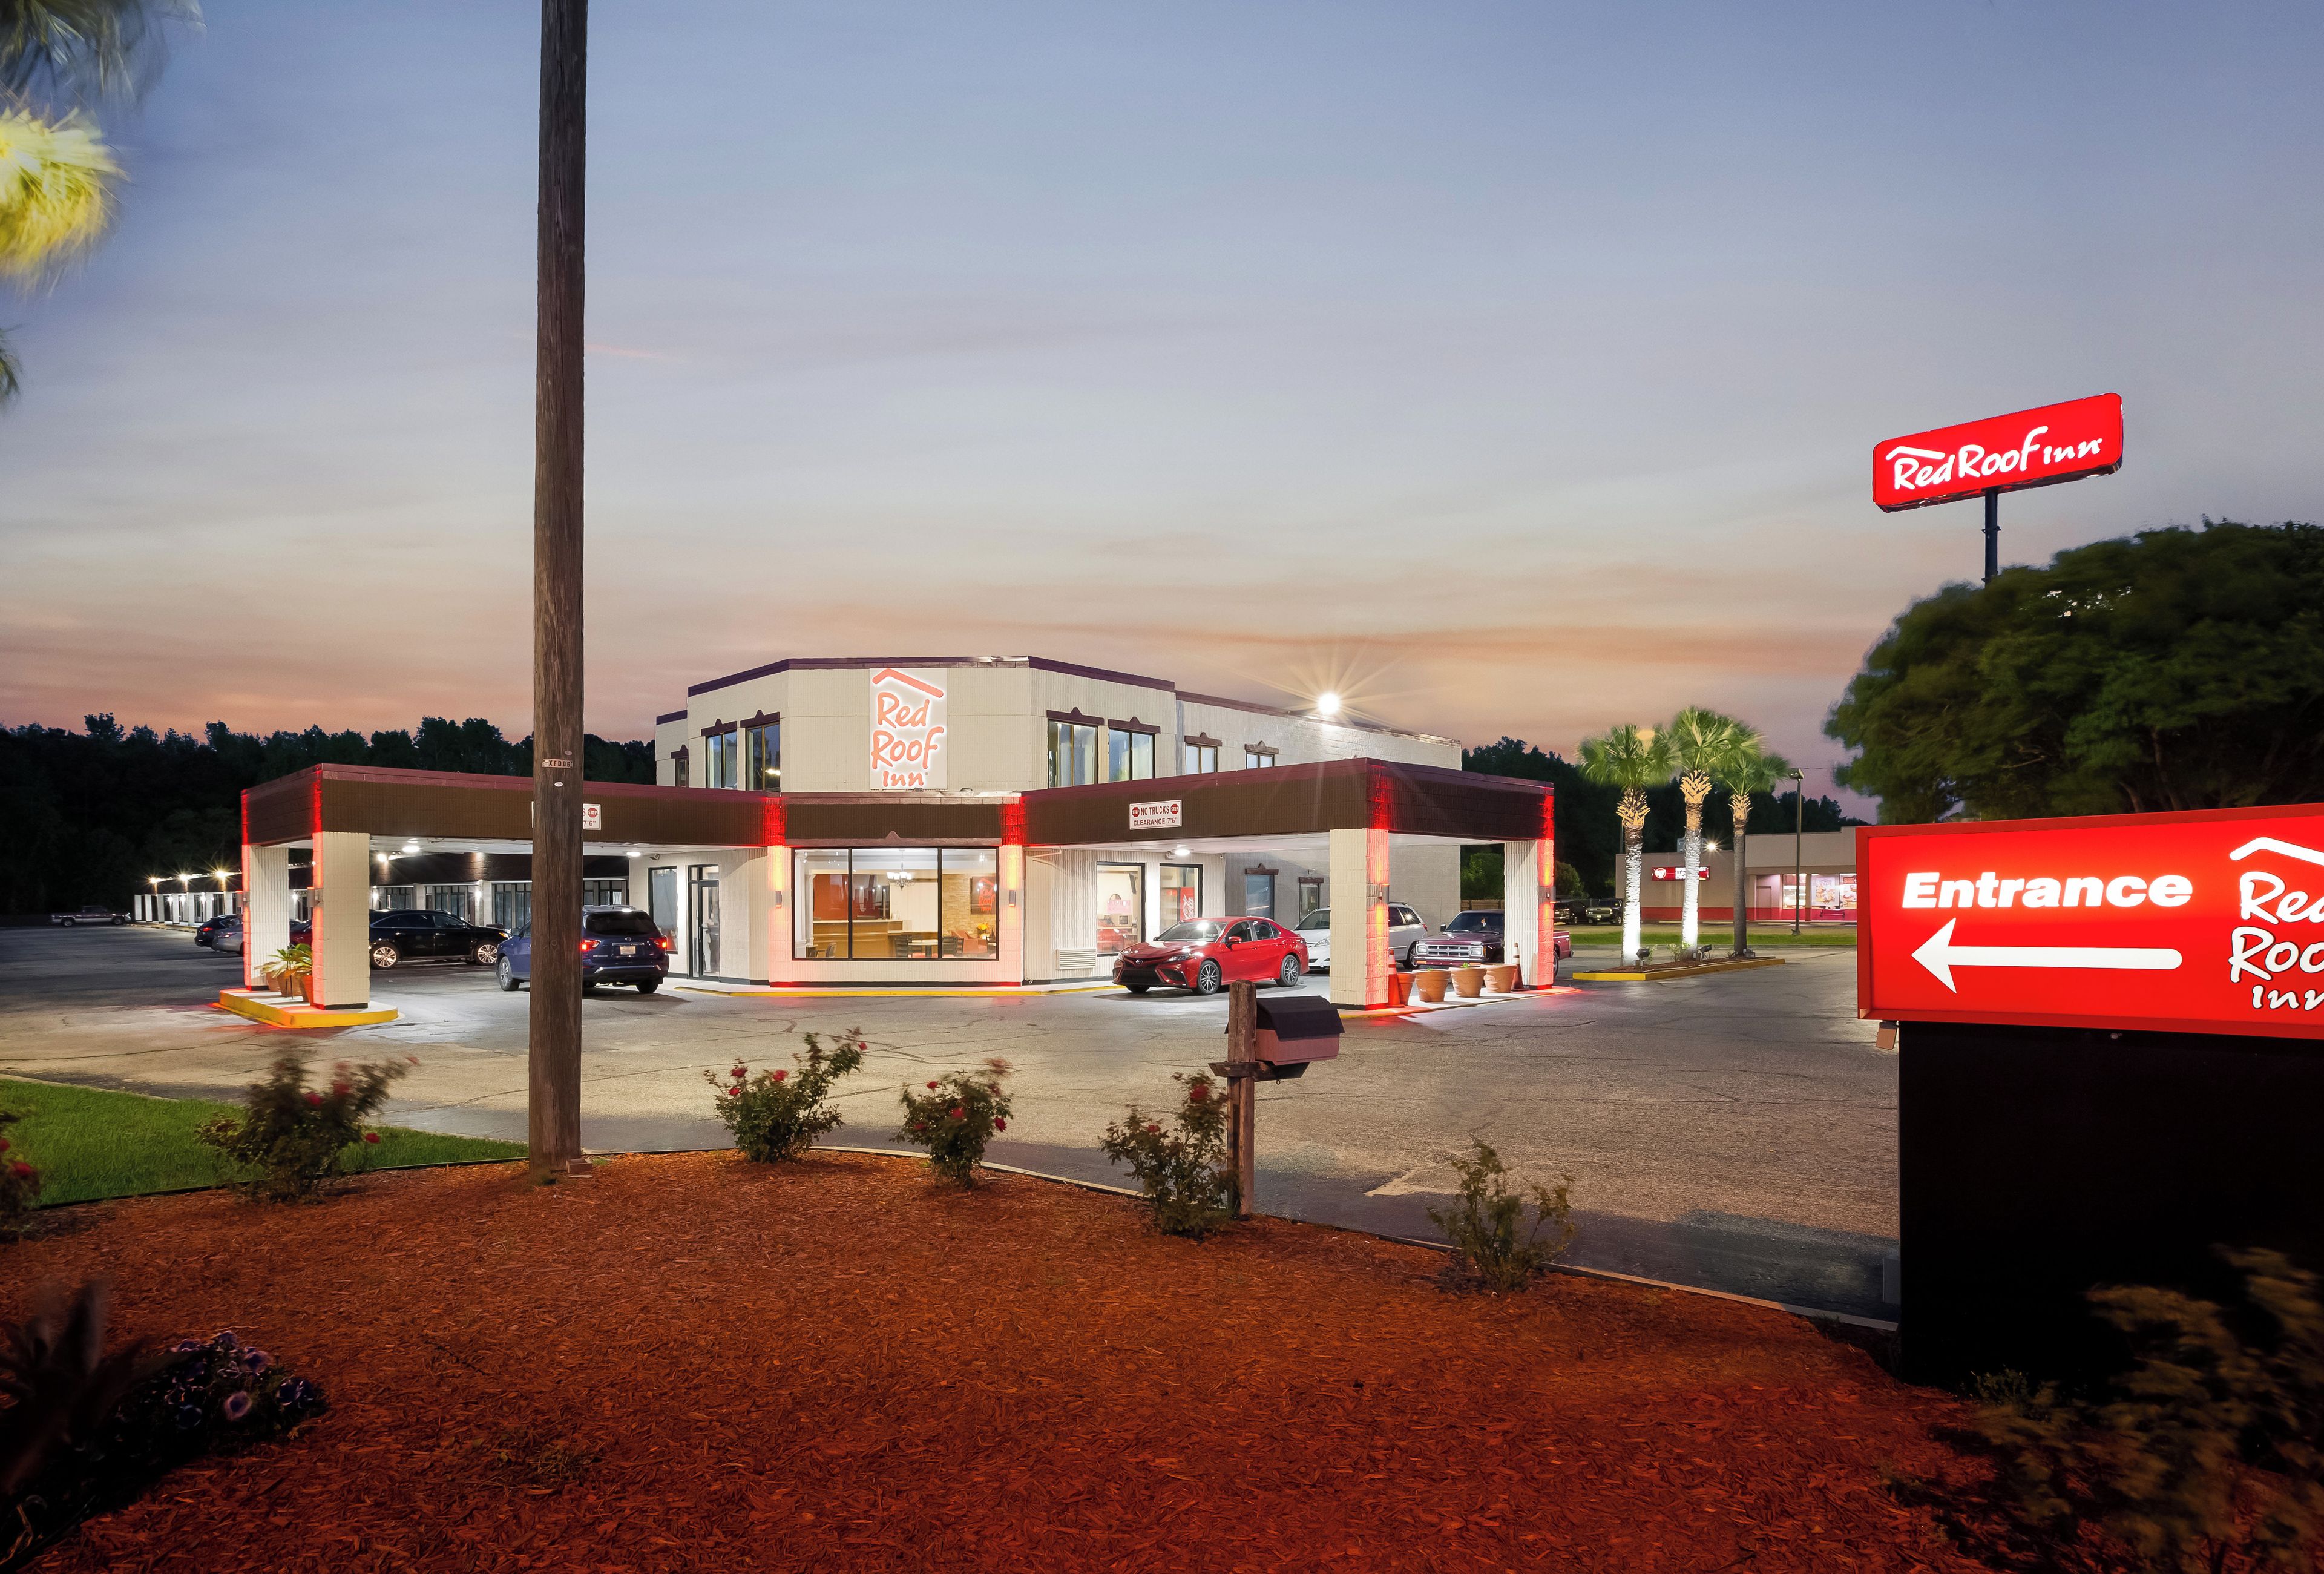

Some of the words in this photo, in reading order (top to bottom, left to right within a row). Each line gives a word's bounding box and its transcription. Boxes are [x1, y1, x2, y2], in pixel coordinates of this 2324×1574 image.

[1894, 454, 1955, 490] Red
[1958, 426, 2049, 479] Roof
[878, 692, 930, 728] Red
[872, 726, 944, 769] Roof
[1141, 807, 1147, 815] NO
[1149, 806, 1169, 815] TRUCKS
[1902, 872, 2193, 908] Entrance
[2228, 926, 2324, 983] Roo
